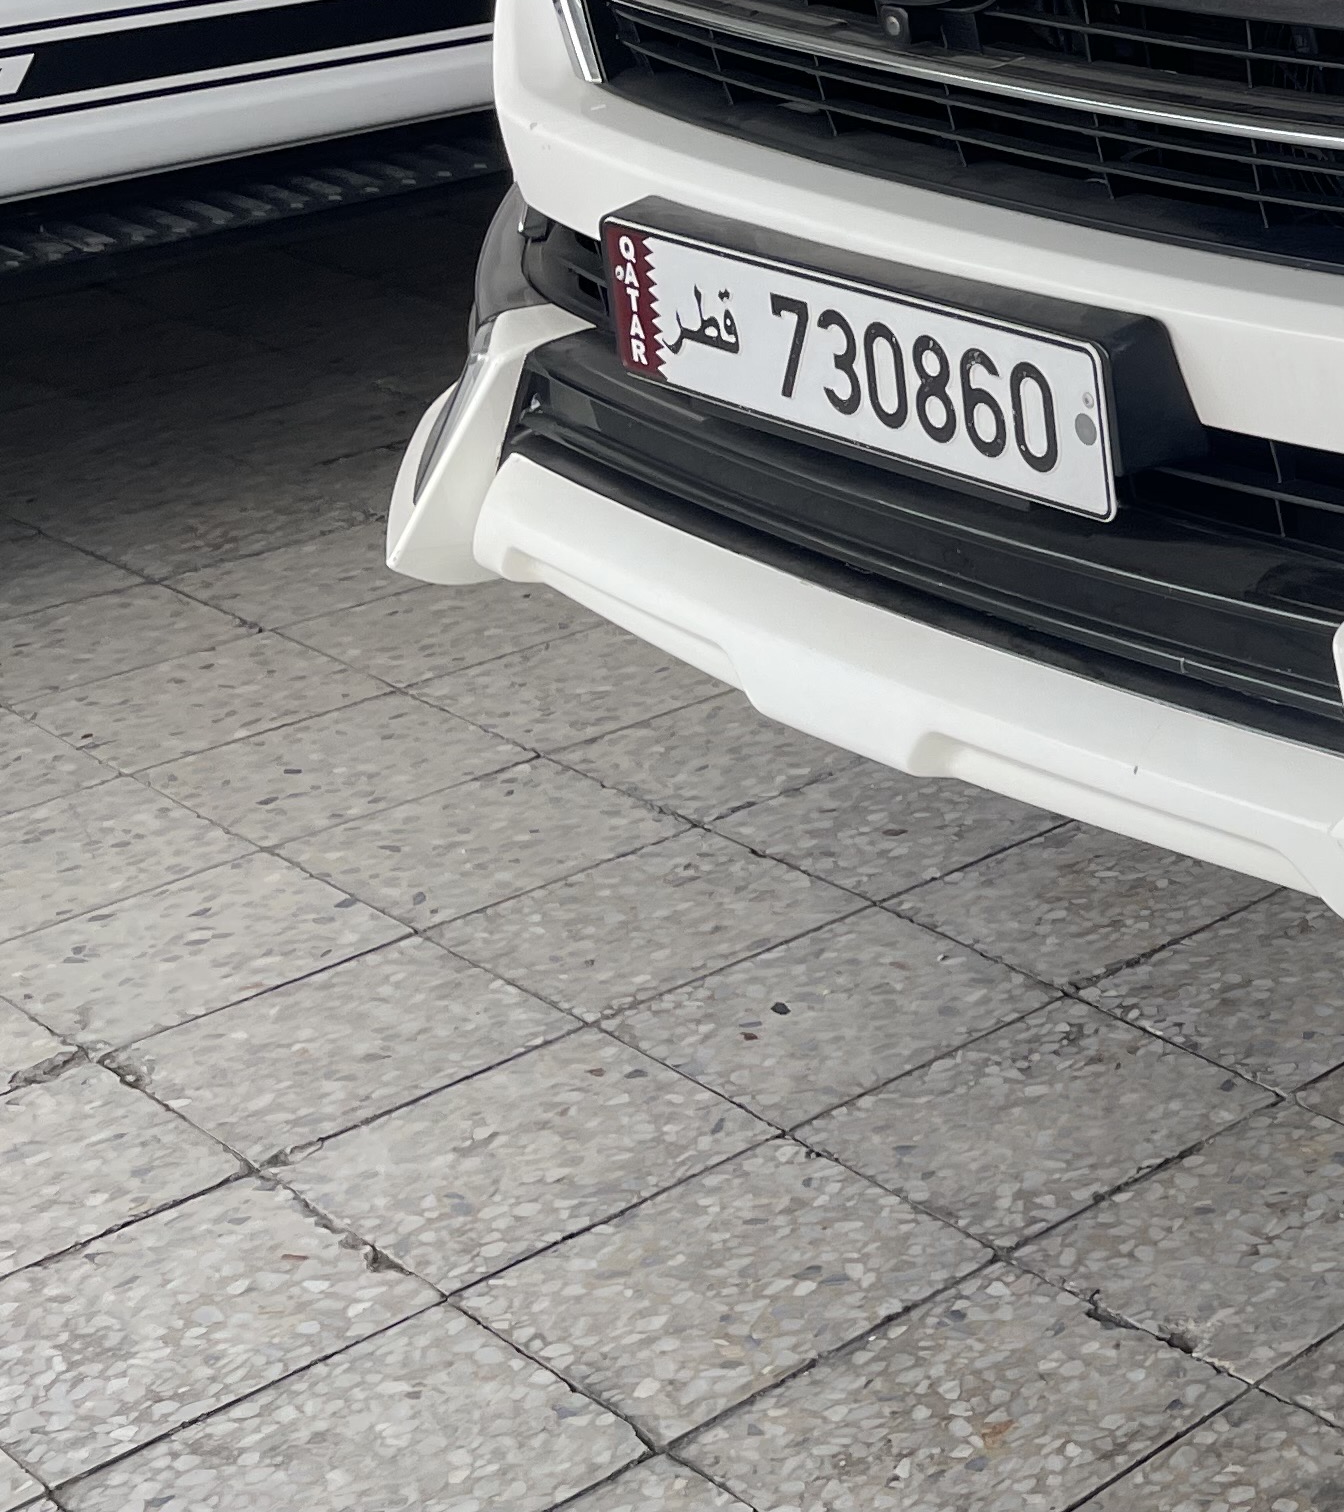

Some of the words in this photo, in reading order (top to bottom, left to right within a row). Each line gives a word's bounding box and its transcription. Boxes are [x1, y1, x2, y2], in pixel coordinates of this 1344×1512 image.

[617, 235, 648, 366] QATAR
[663, 284, 740, 355] قطر
[769, 291, 1059, 474] 730860
